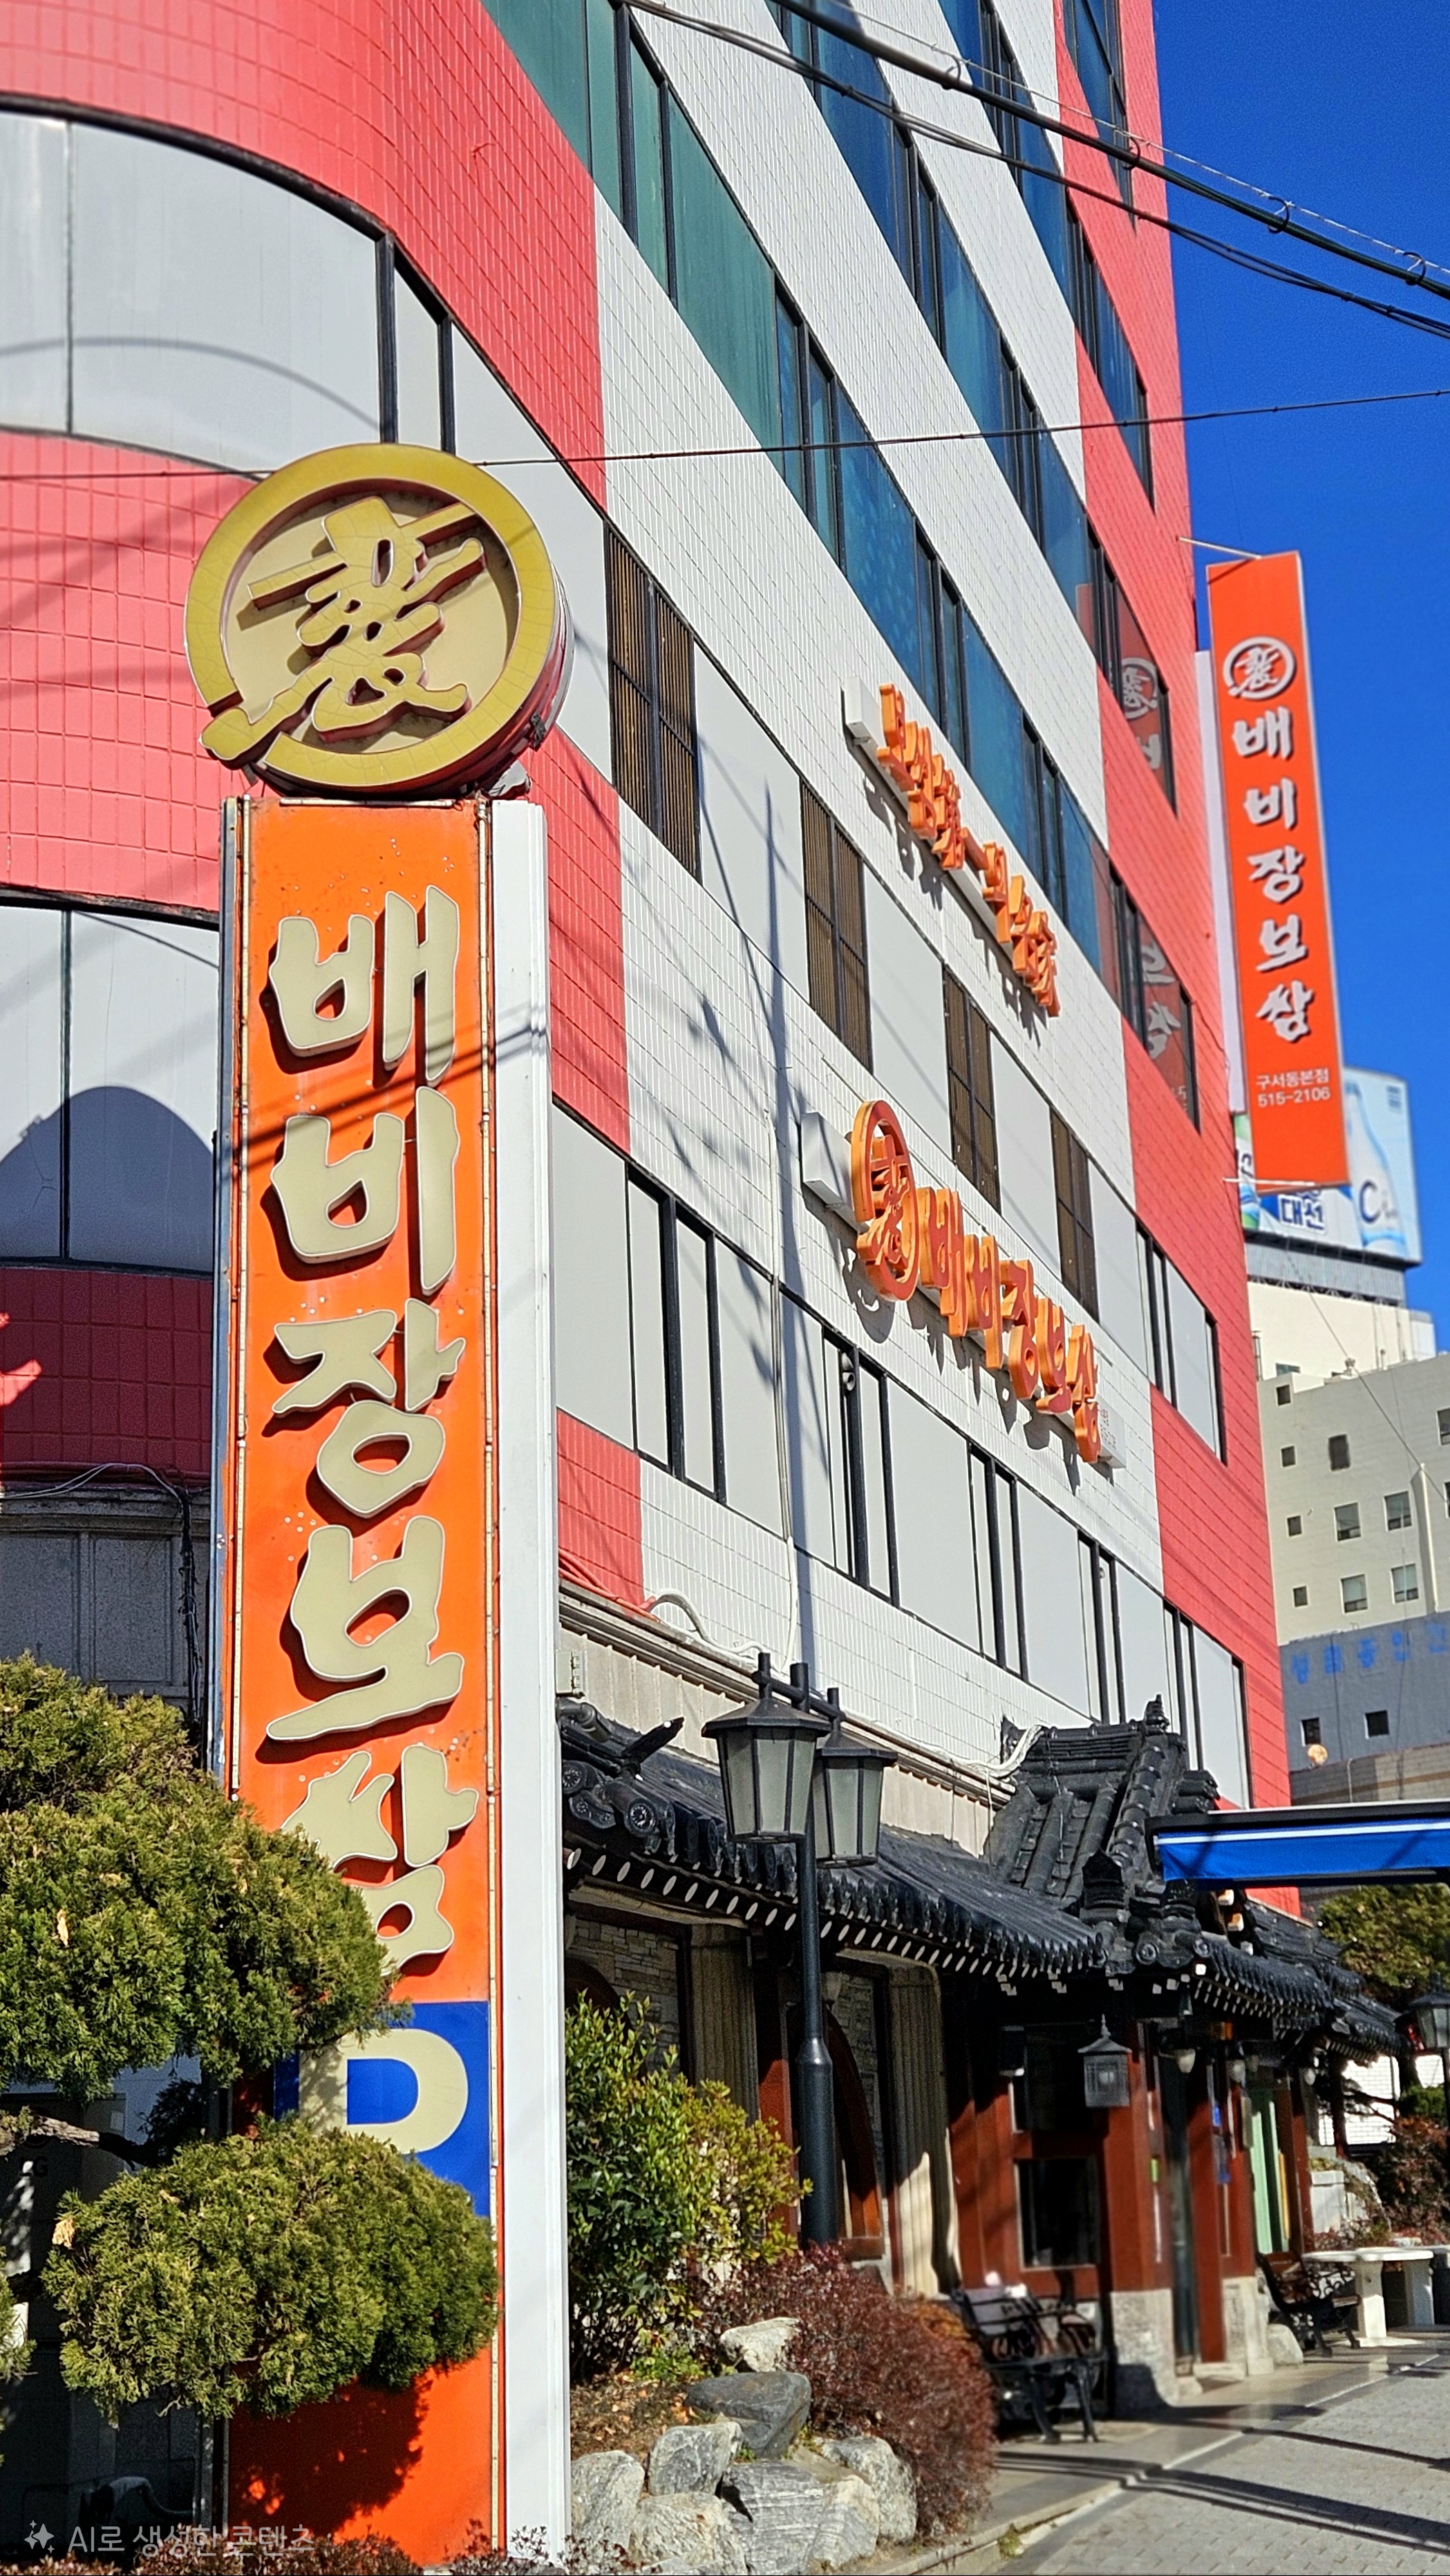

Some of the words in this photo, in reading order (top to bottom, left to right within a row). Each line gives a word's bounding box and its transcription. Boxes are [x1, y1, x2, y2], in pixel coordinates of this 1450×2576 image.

[1232, 706, 1313, 1041] 배비장보쌈
[1256, 1068, 1330, 1090] 구서동본점
[1258, 1087, 1331, 1108] 515-2106
[1281, 1198, 1325, 1230] 대선
[916, 1186, 1102, 1463] 배비장보쌈
[267, 884, 479, 1976] 배비장보쌈
